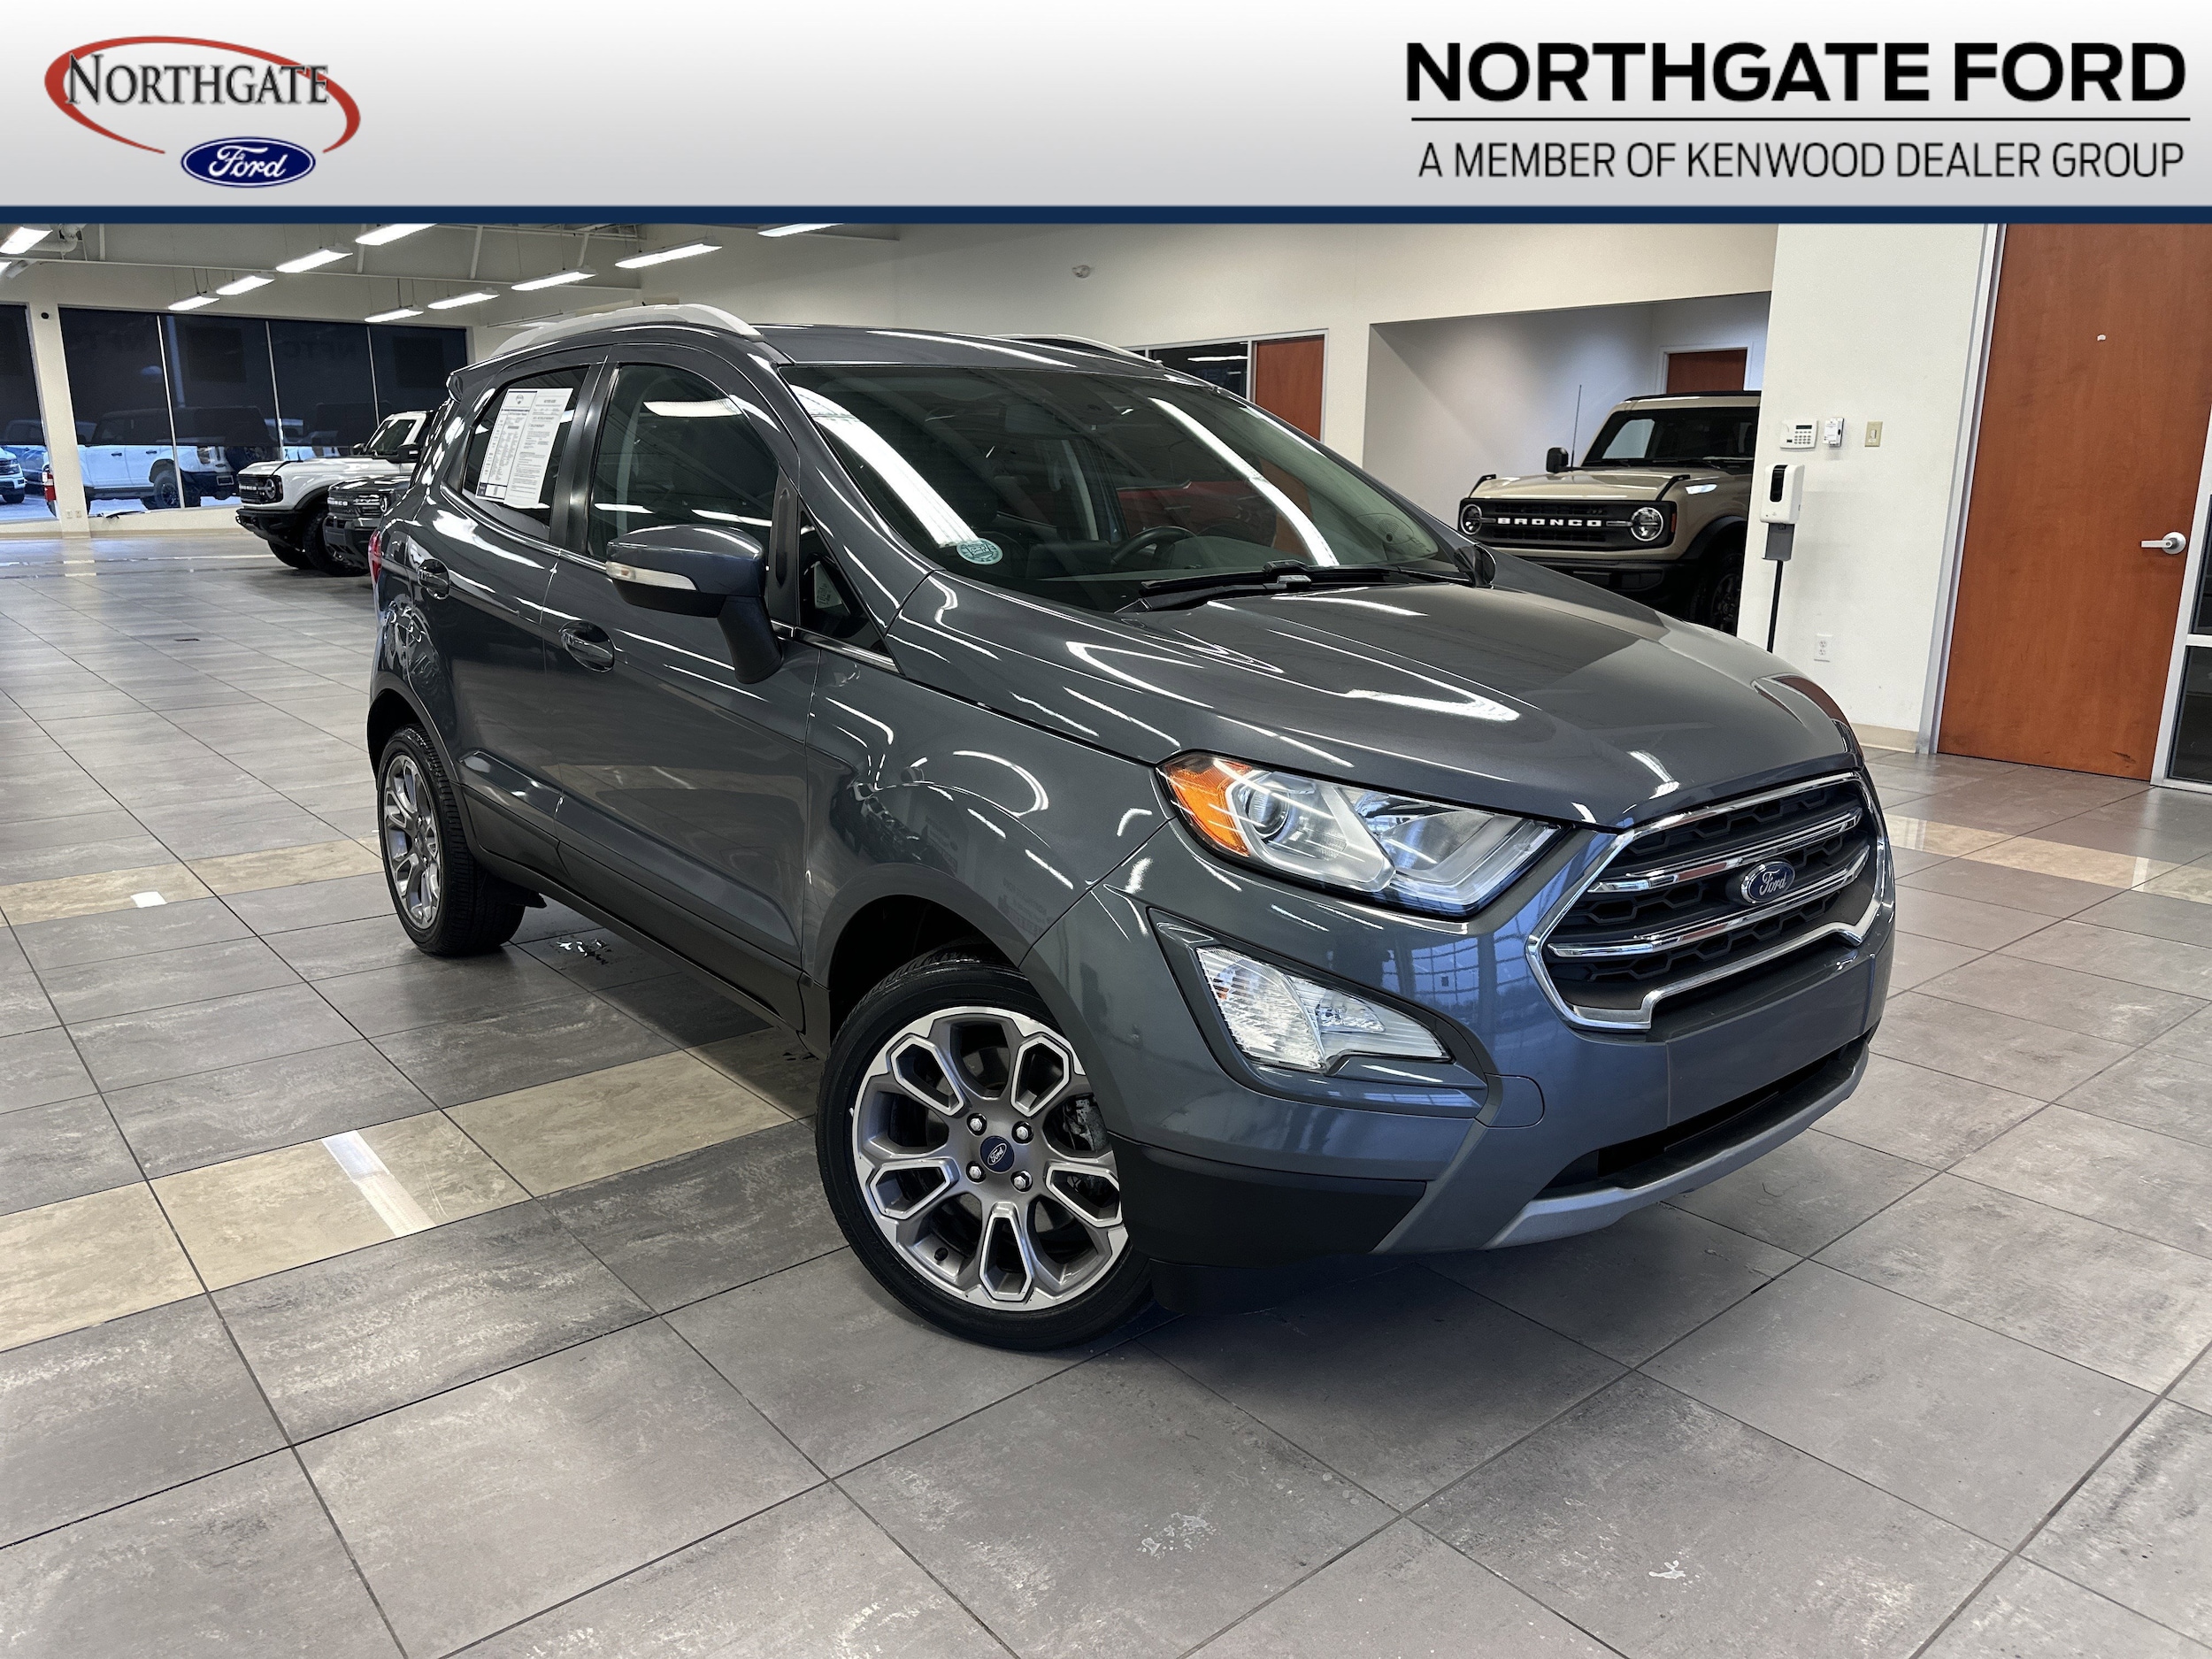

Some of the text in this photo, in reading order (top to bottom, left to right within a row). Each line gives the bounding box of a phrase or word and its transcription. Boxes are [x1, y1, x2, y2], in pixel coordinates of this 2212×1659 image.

[1497, 518, 1602, 527] BRONCO
[1759, 869, 1787, 896] Ford
[990, 1147, 1005, 1164] Ford
